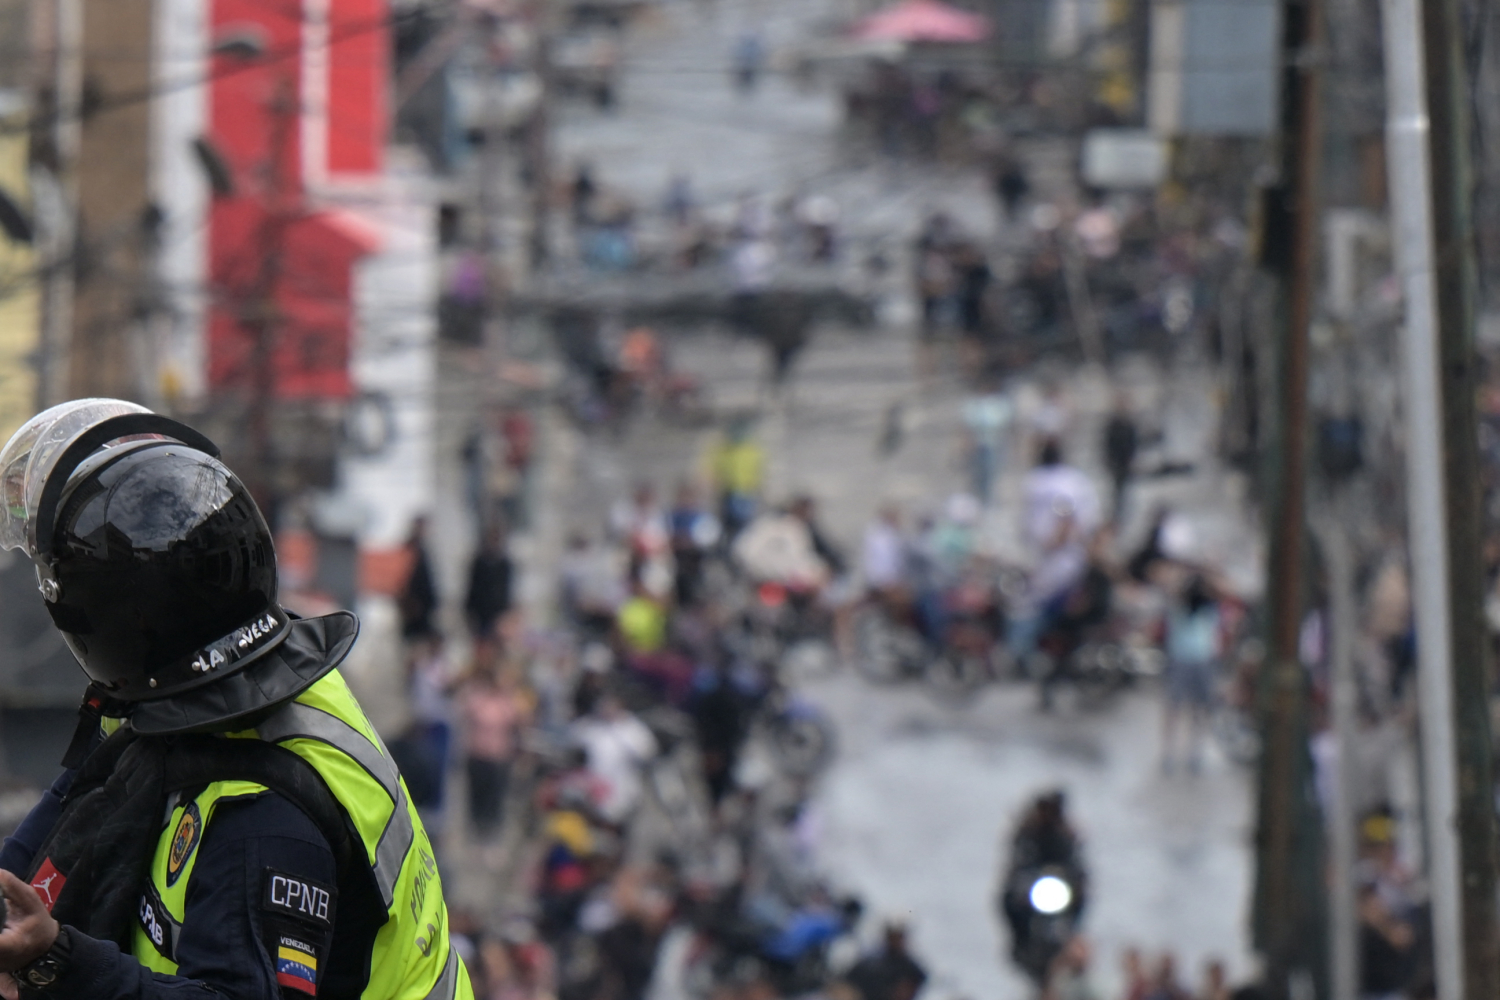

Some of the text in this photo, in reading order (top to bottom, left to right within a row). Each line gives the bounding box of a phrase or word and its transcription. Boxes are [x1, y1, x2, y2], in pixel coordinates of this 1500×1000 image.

[199, 613, 279, 672] LA VEGA
[271, 875, 330, 920] CPNB
[280, 935, 316, 956] VENEZUELA
